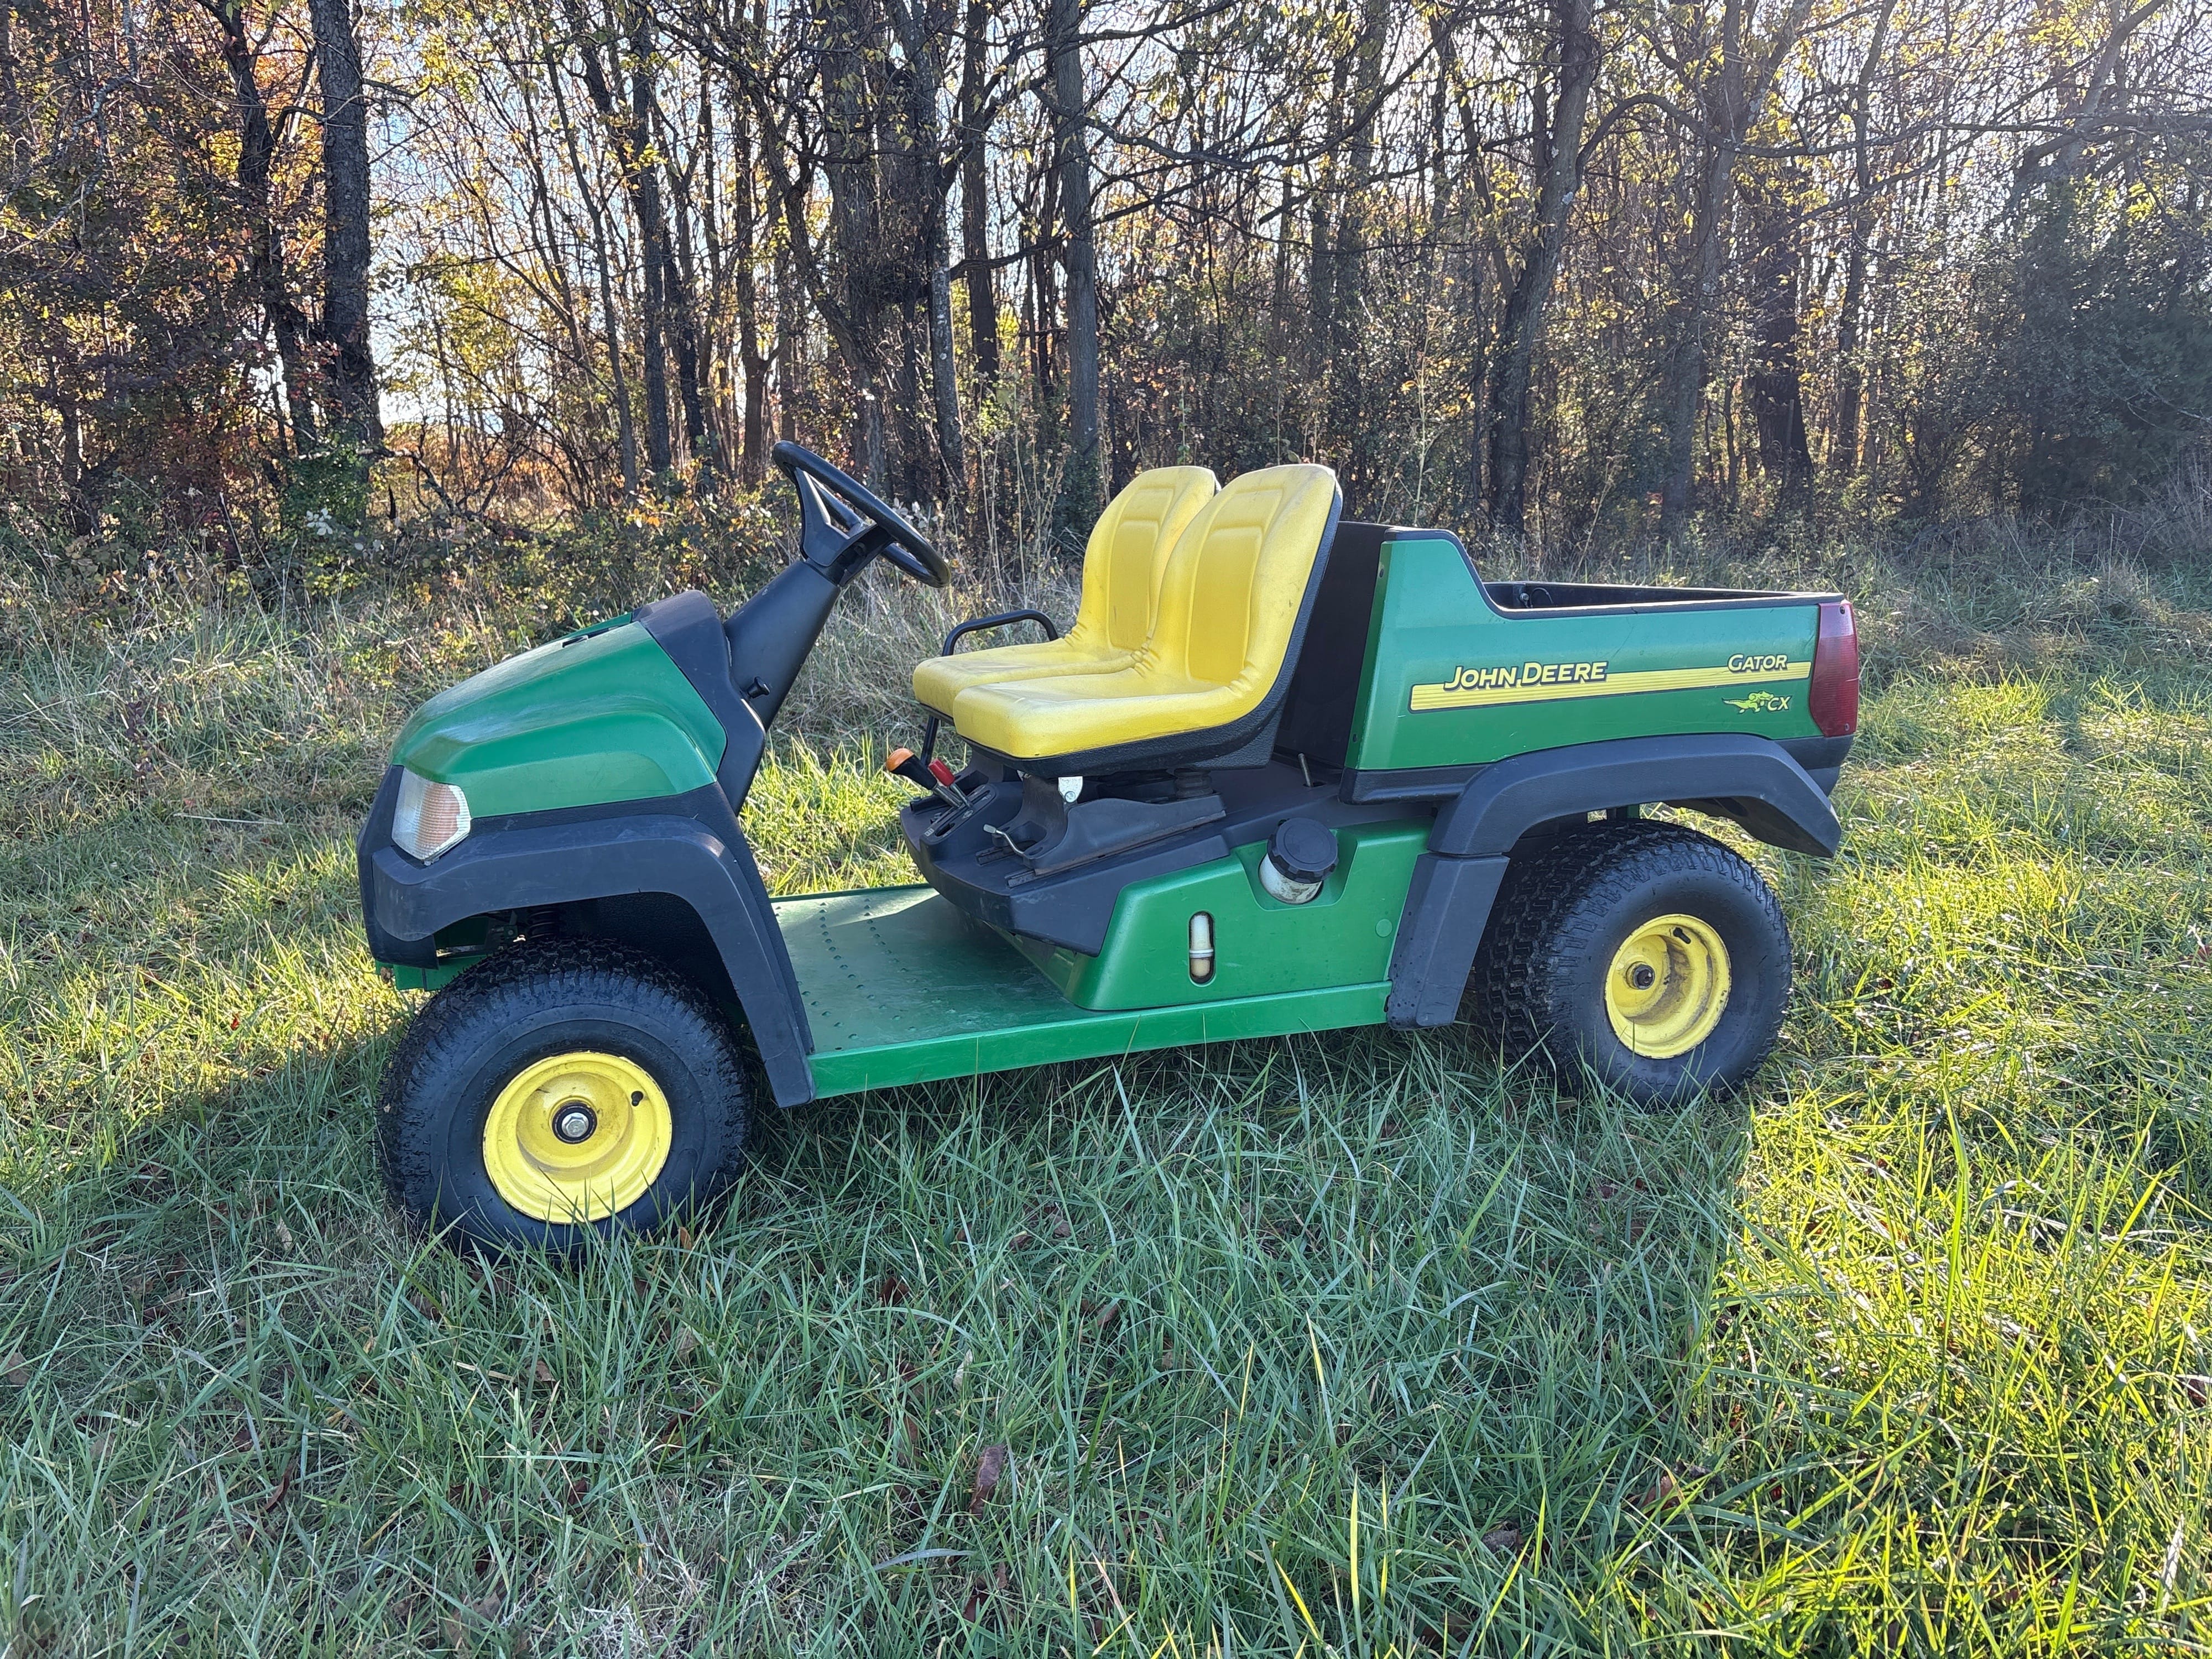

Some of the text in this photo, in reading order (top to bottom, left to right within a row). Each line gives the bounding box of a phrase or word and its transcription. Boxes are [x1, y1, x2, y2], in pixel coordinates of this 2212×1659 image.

[1728, 654, 1788, 672] GATOR
[1444, 661, 1608, 690] JOHN DEERE
[1767, 696, 1791, 712] CX
